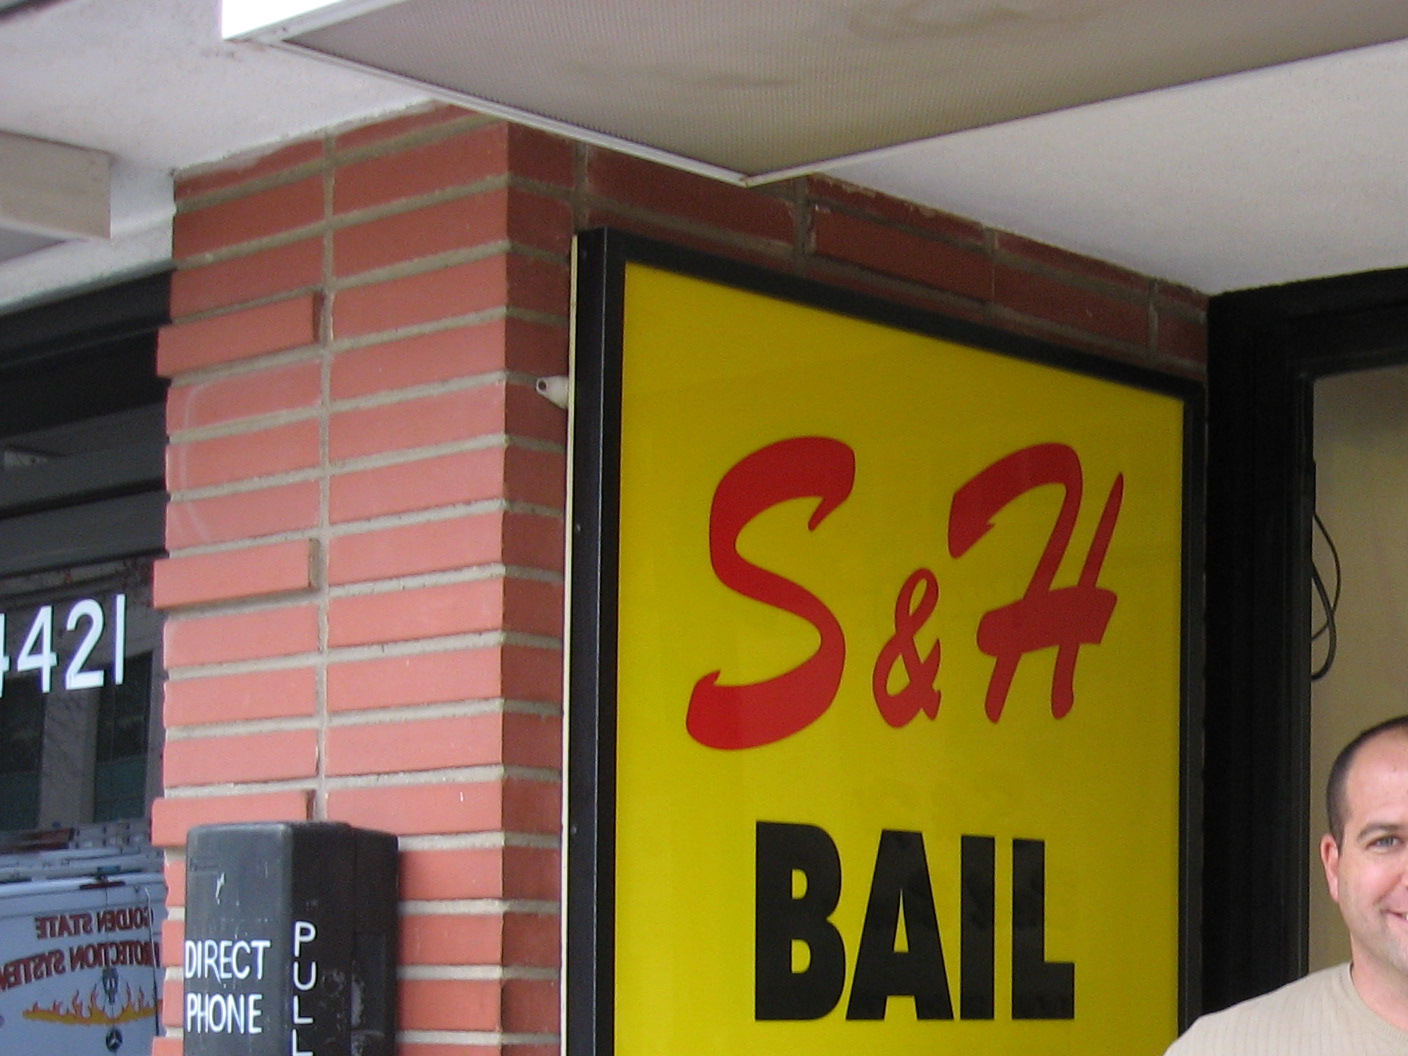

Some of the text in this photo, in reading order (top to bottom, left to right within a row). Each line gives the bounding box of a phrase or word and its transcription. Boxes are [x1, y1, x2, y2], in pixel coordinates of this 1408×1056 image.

[686, 436, 1123, 750] S & H
[184, 940, 271, 983] DIRECT
[755, 821, 1075, 1020] BAIL
[186, 993, 263, 1034] PHONE
